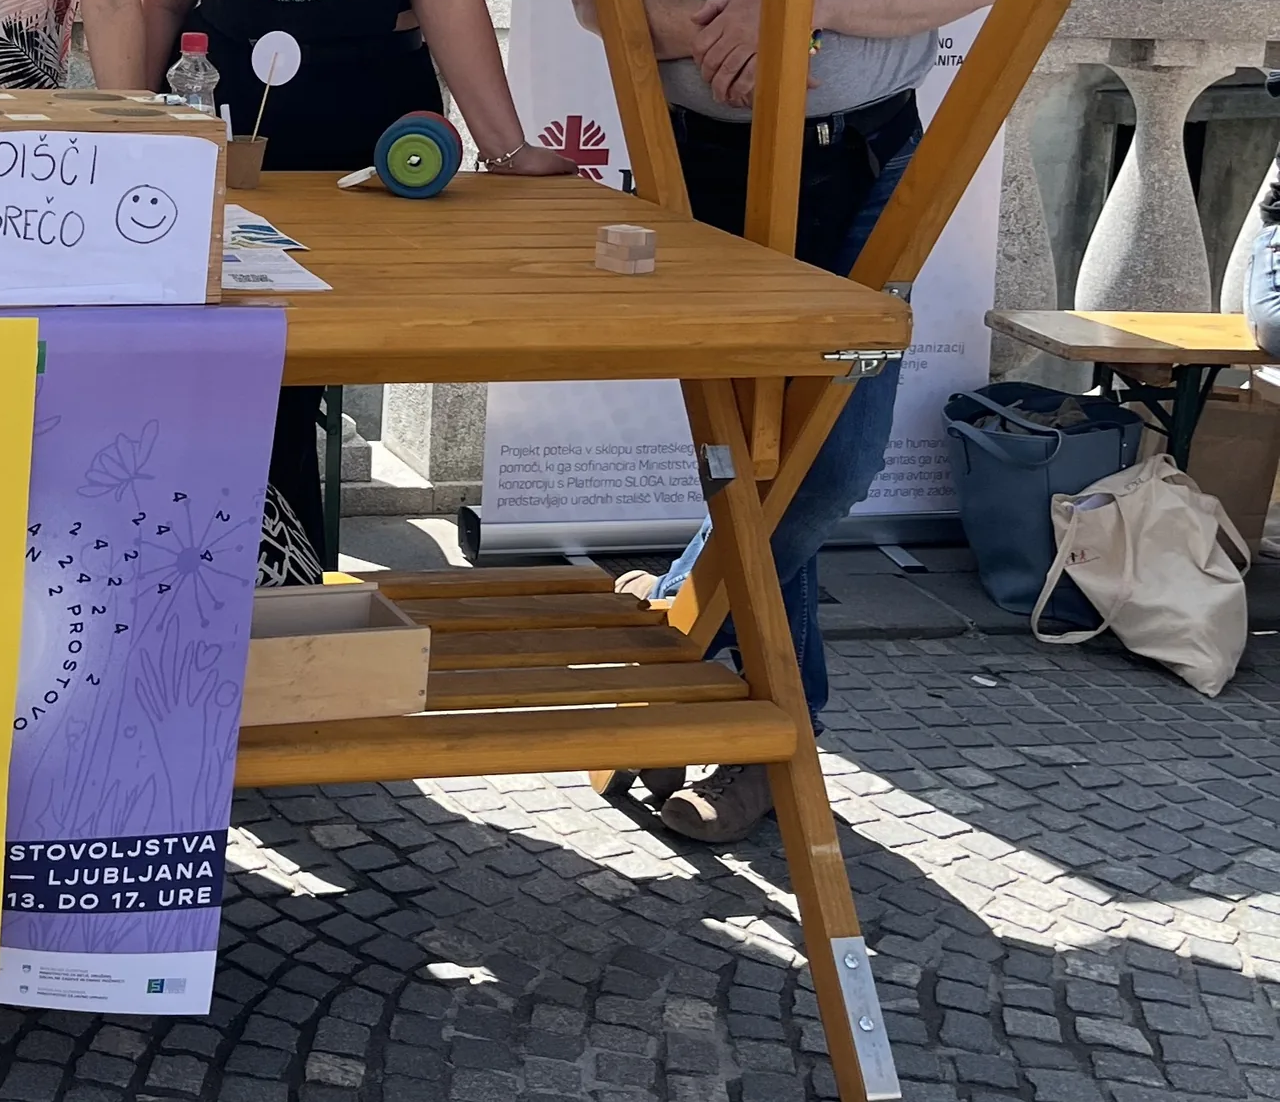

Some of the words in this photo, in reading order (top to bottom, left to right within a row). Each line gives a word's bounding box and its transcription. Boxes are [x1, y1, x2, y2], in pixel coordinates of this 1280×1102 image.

[909, 342, 965, 355] ganizacij
[500, 444, 541, 459] Projekt
[543, 444, 583, 460] poteka
[595, 443, 632, 458] sklopu
[635, 442, 695, 458] strateškeg
[557, 463, 572, 476] ga
[574, 460, 636, 472] sofinancira
[567, 476, 621, 489] Platformo
[653, 490, 685, 503] Vlade
[13, 604, 84, 730] PROSTOVO
[9, 835, 216, 861] STOVOLJSTVA
[48, 861, 213, 885] LJUBLJANA
[7, 892, 45, 909] 13.
[58, 893, 100, 910] DO
[111, 891, 146, 909] 17.
[158, 887, 212, 906] URE
